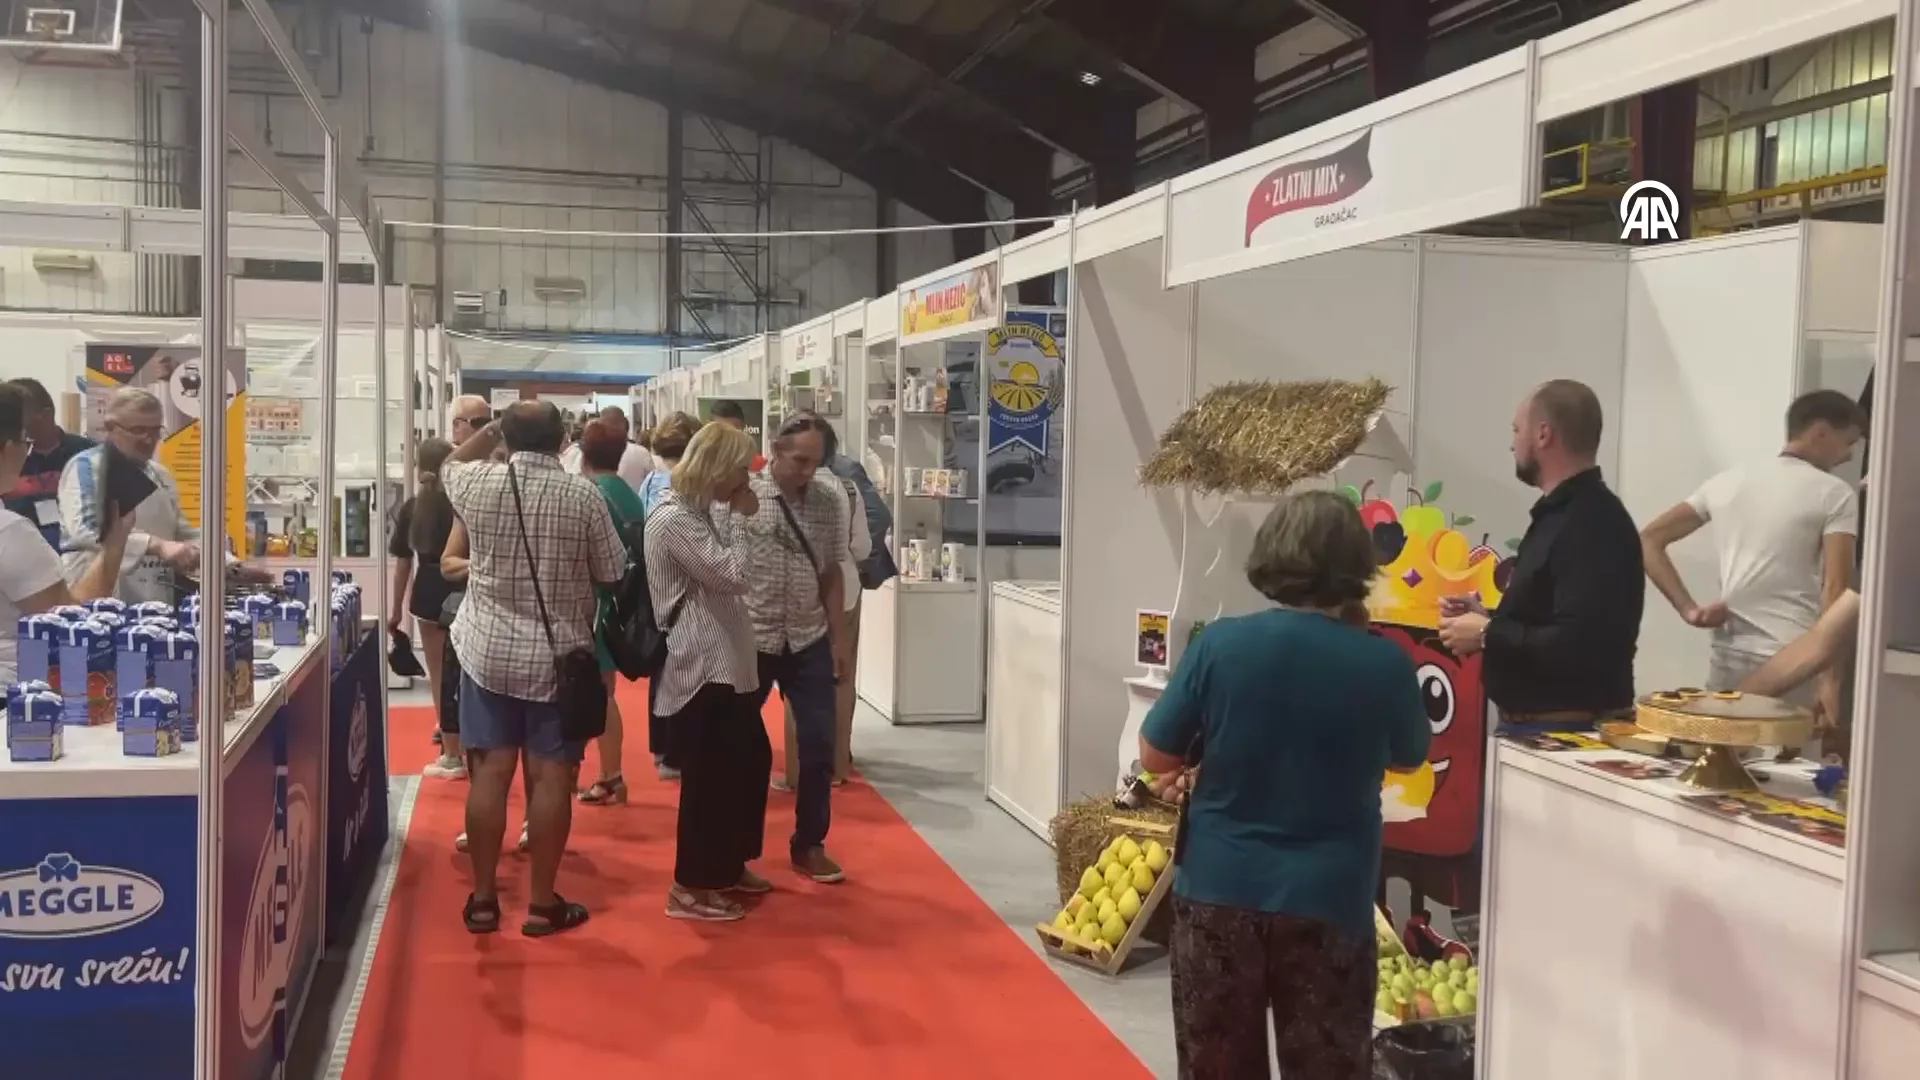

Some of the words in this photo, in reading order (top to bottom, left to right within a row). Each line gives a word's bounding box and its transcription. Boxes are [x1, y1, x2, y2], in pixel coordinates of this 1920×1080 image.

[1272, 169, 1312, 207] ZLATNI
[1313, 163, 1338, 197] MIX
[1314, 206, 1358, 228] GRADAČAC
[0, 884, 134, 917] MEGGLE
[0, 963, 64, 992] svu
[75, 947, 189, 988] sreću!
